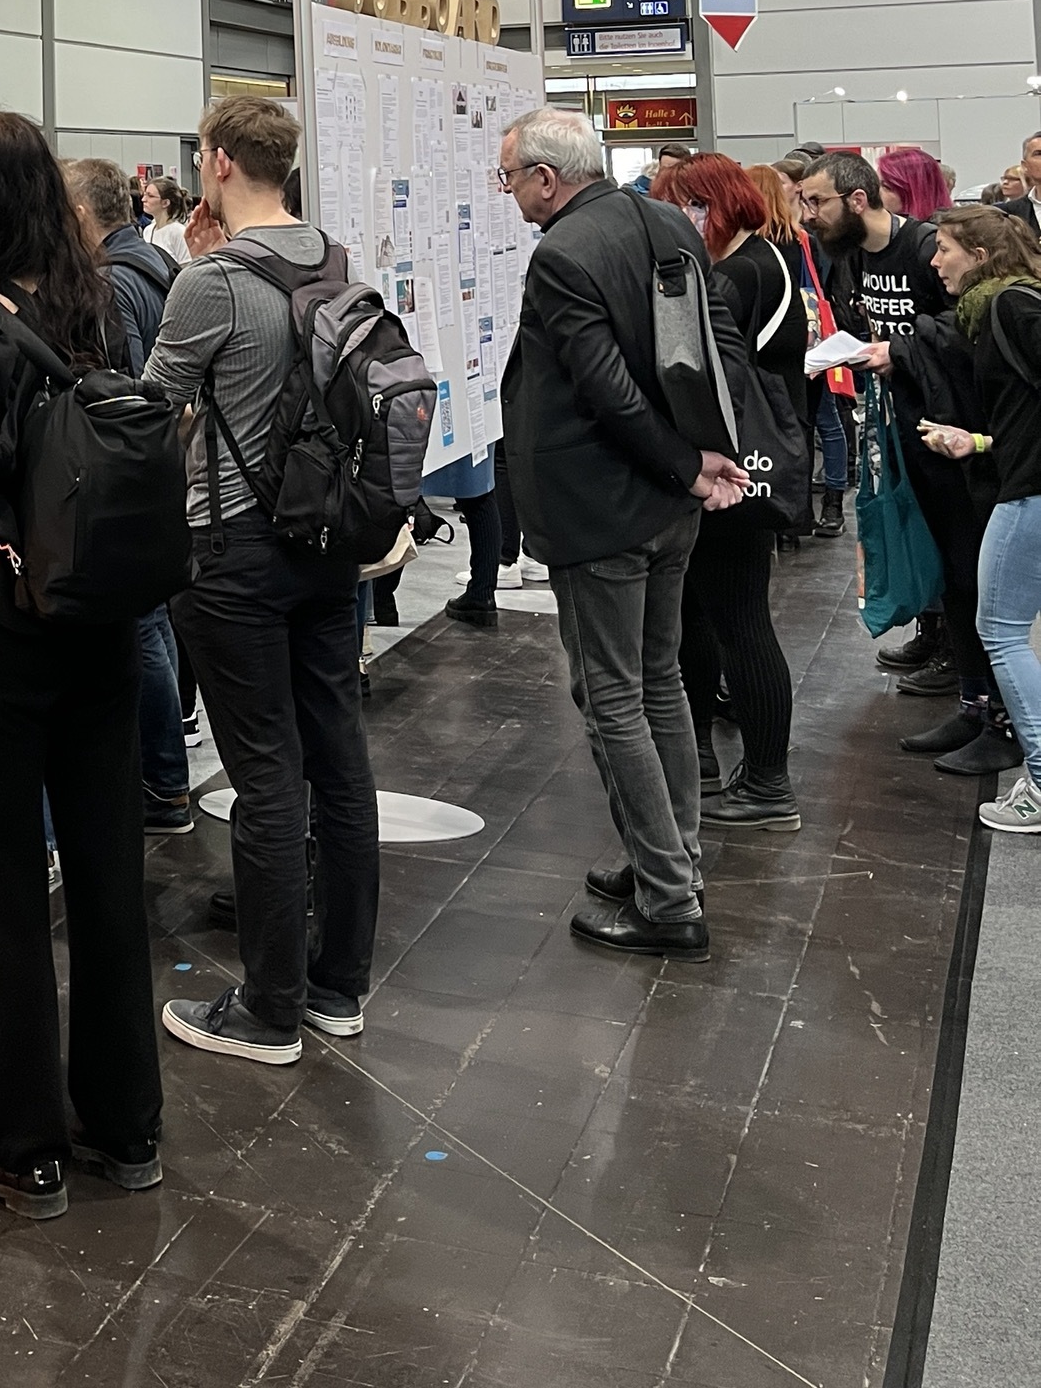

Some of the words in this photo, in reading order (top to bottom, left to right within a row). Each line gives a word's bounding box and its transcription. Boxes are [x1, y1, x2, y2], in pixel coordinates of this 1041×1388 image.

[645, 109, 668, 118] Halle
[669, 109, 676, 118] 3
[861, 293, 916, 316] PREFER
[870, 318, 885, 336] OT
[885, 321, 915, 336] TO
[743, 449, 773, 472] do
